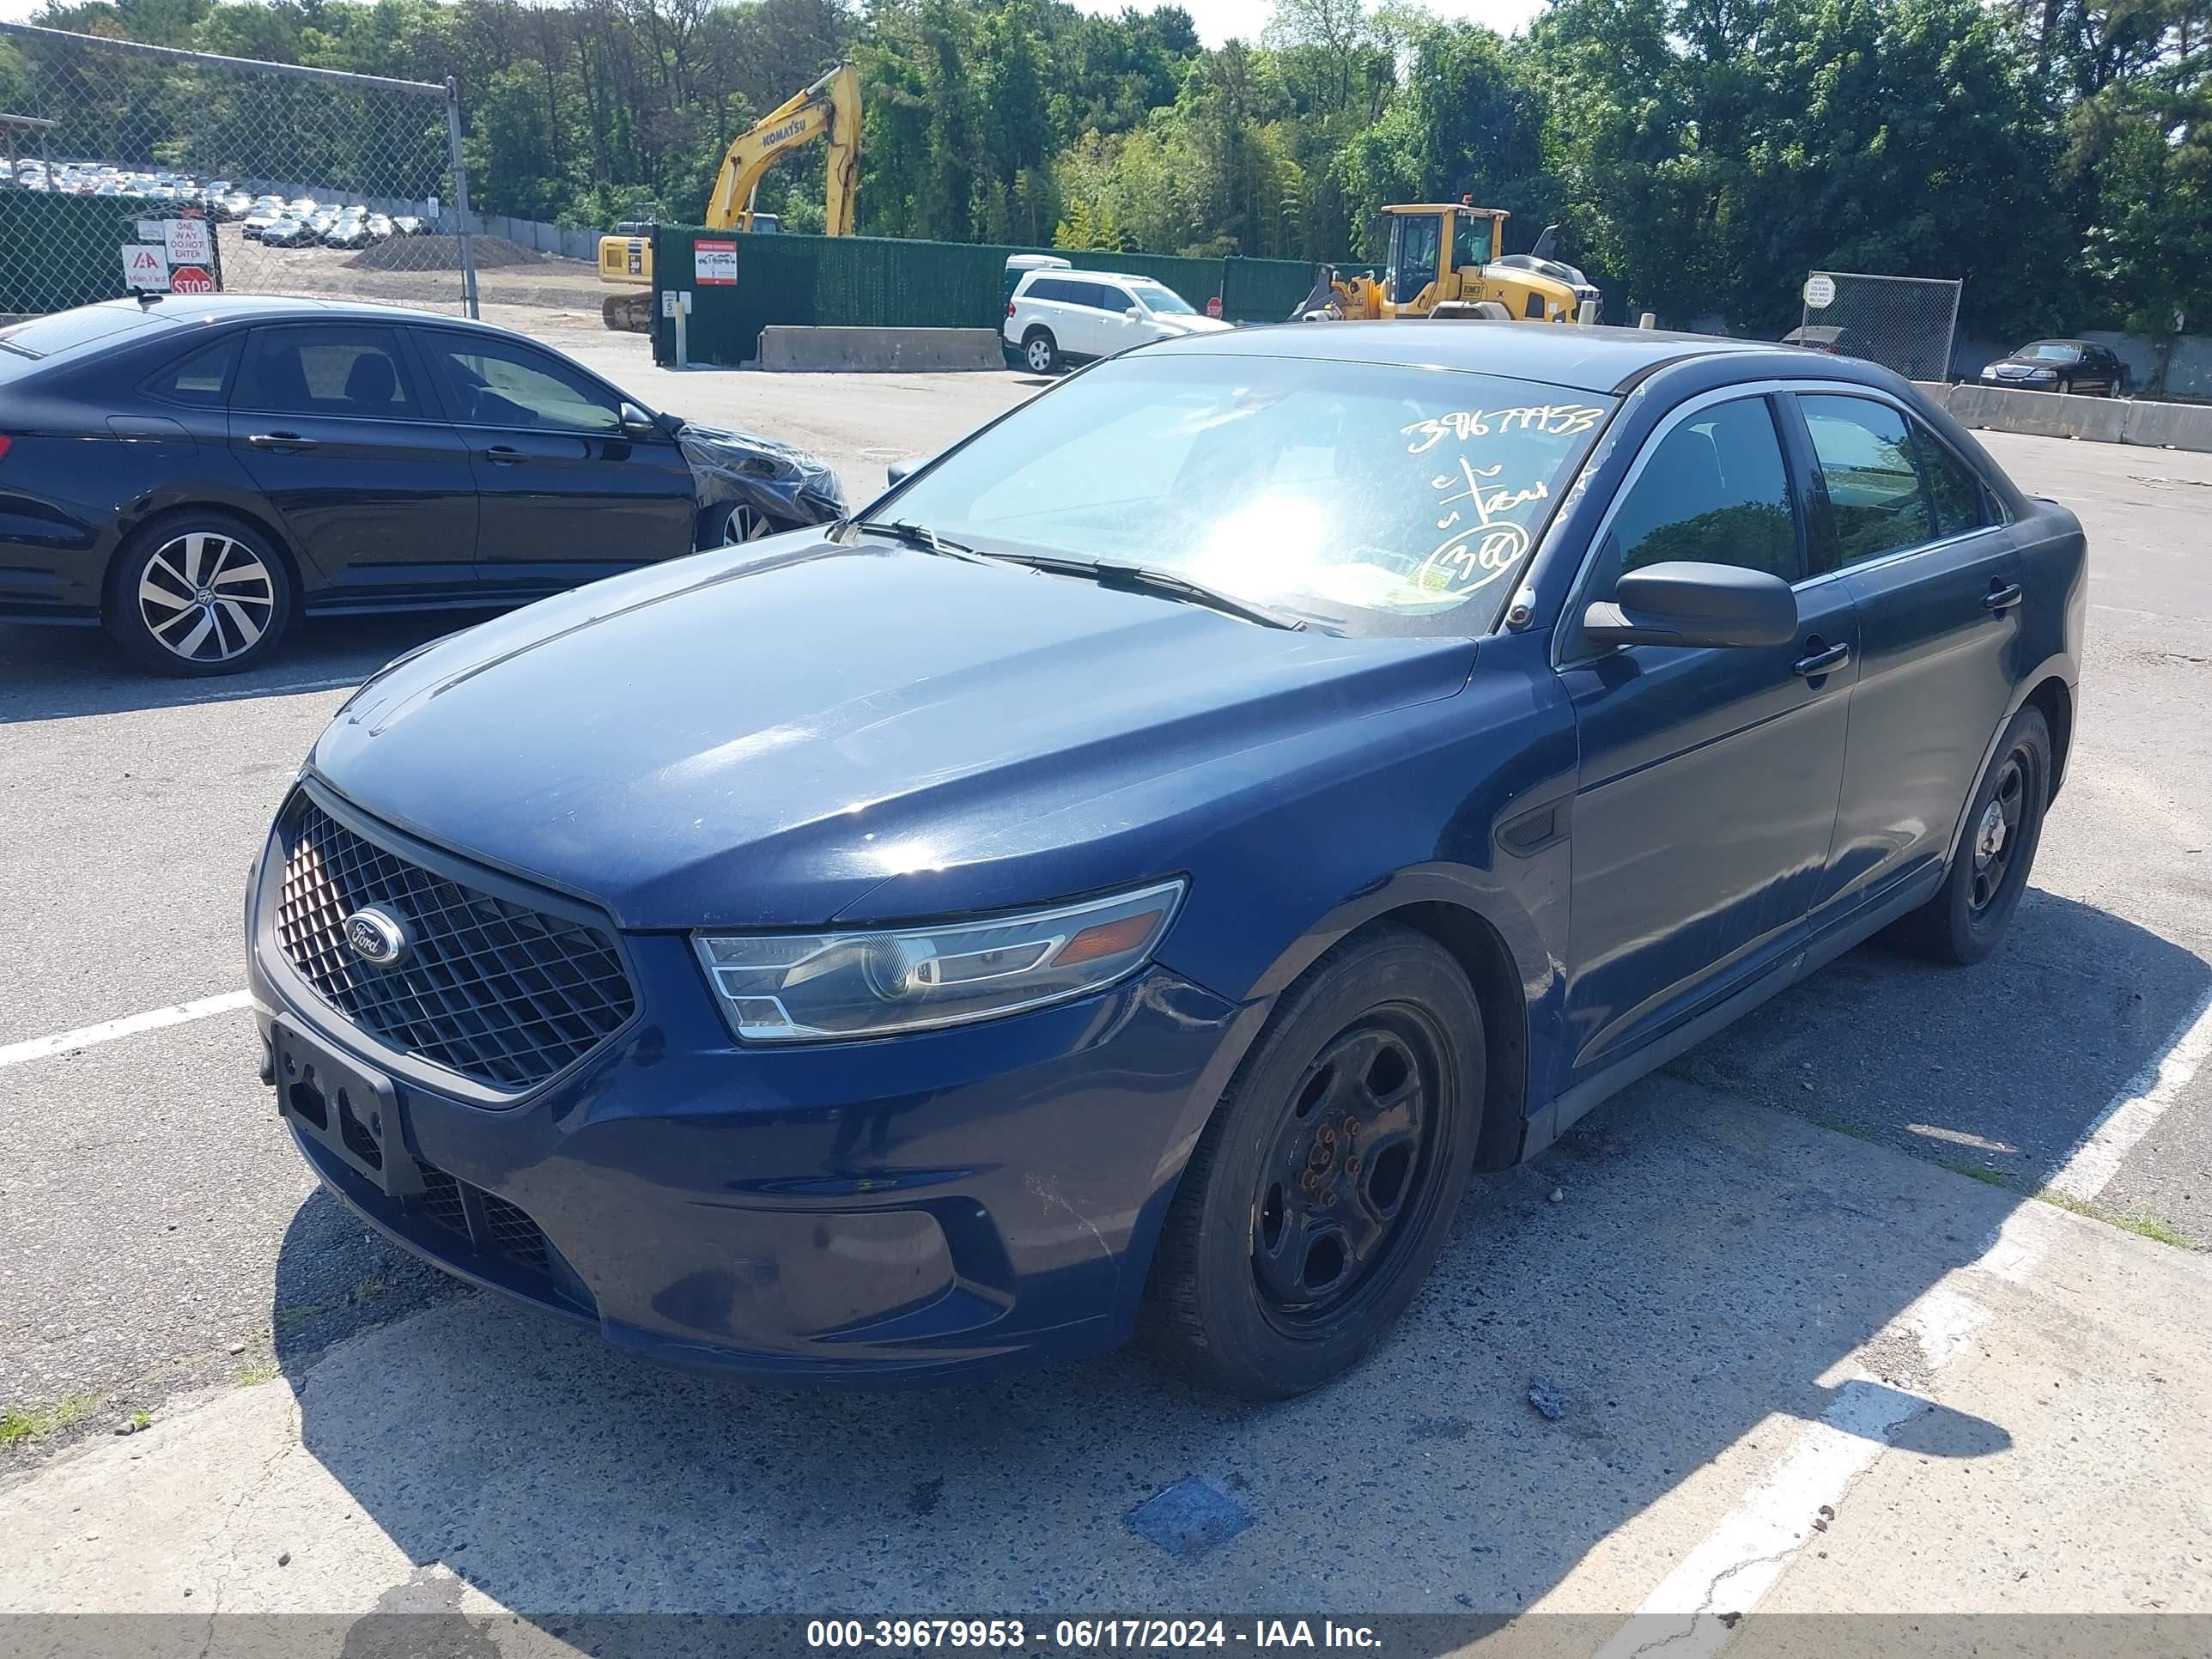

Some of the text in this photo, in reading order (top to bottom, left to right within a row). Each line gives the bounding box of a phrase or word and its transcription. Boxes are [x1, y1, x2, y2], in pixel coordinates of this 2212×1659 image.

[763, 119, 806, 147] KOMATSU
[173, 279, 211, 294] STOP
[667, 302, 672, 311] 5
[1207, 306, 1221, 316] STOP
[351, 921, 380, 954] Ford
